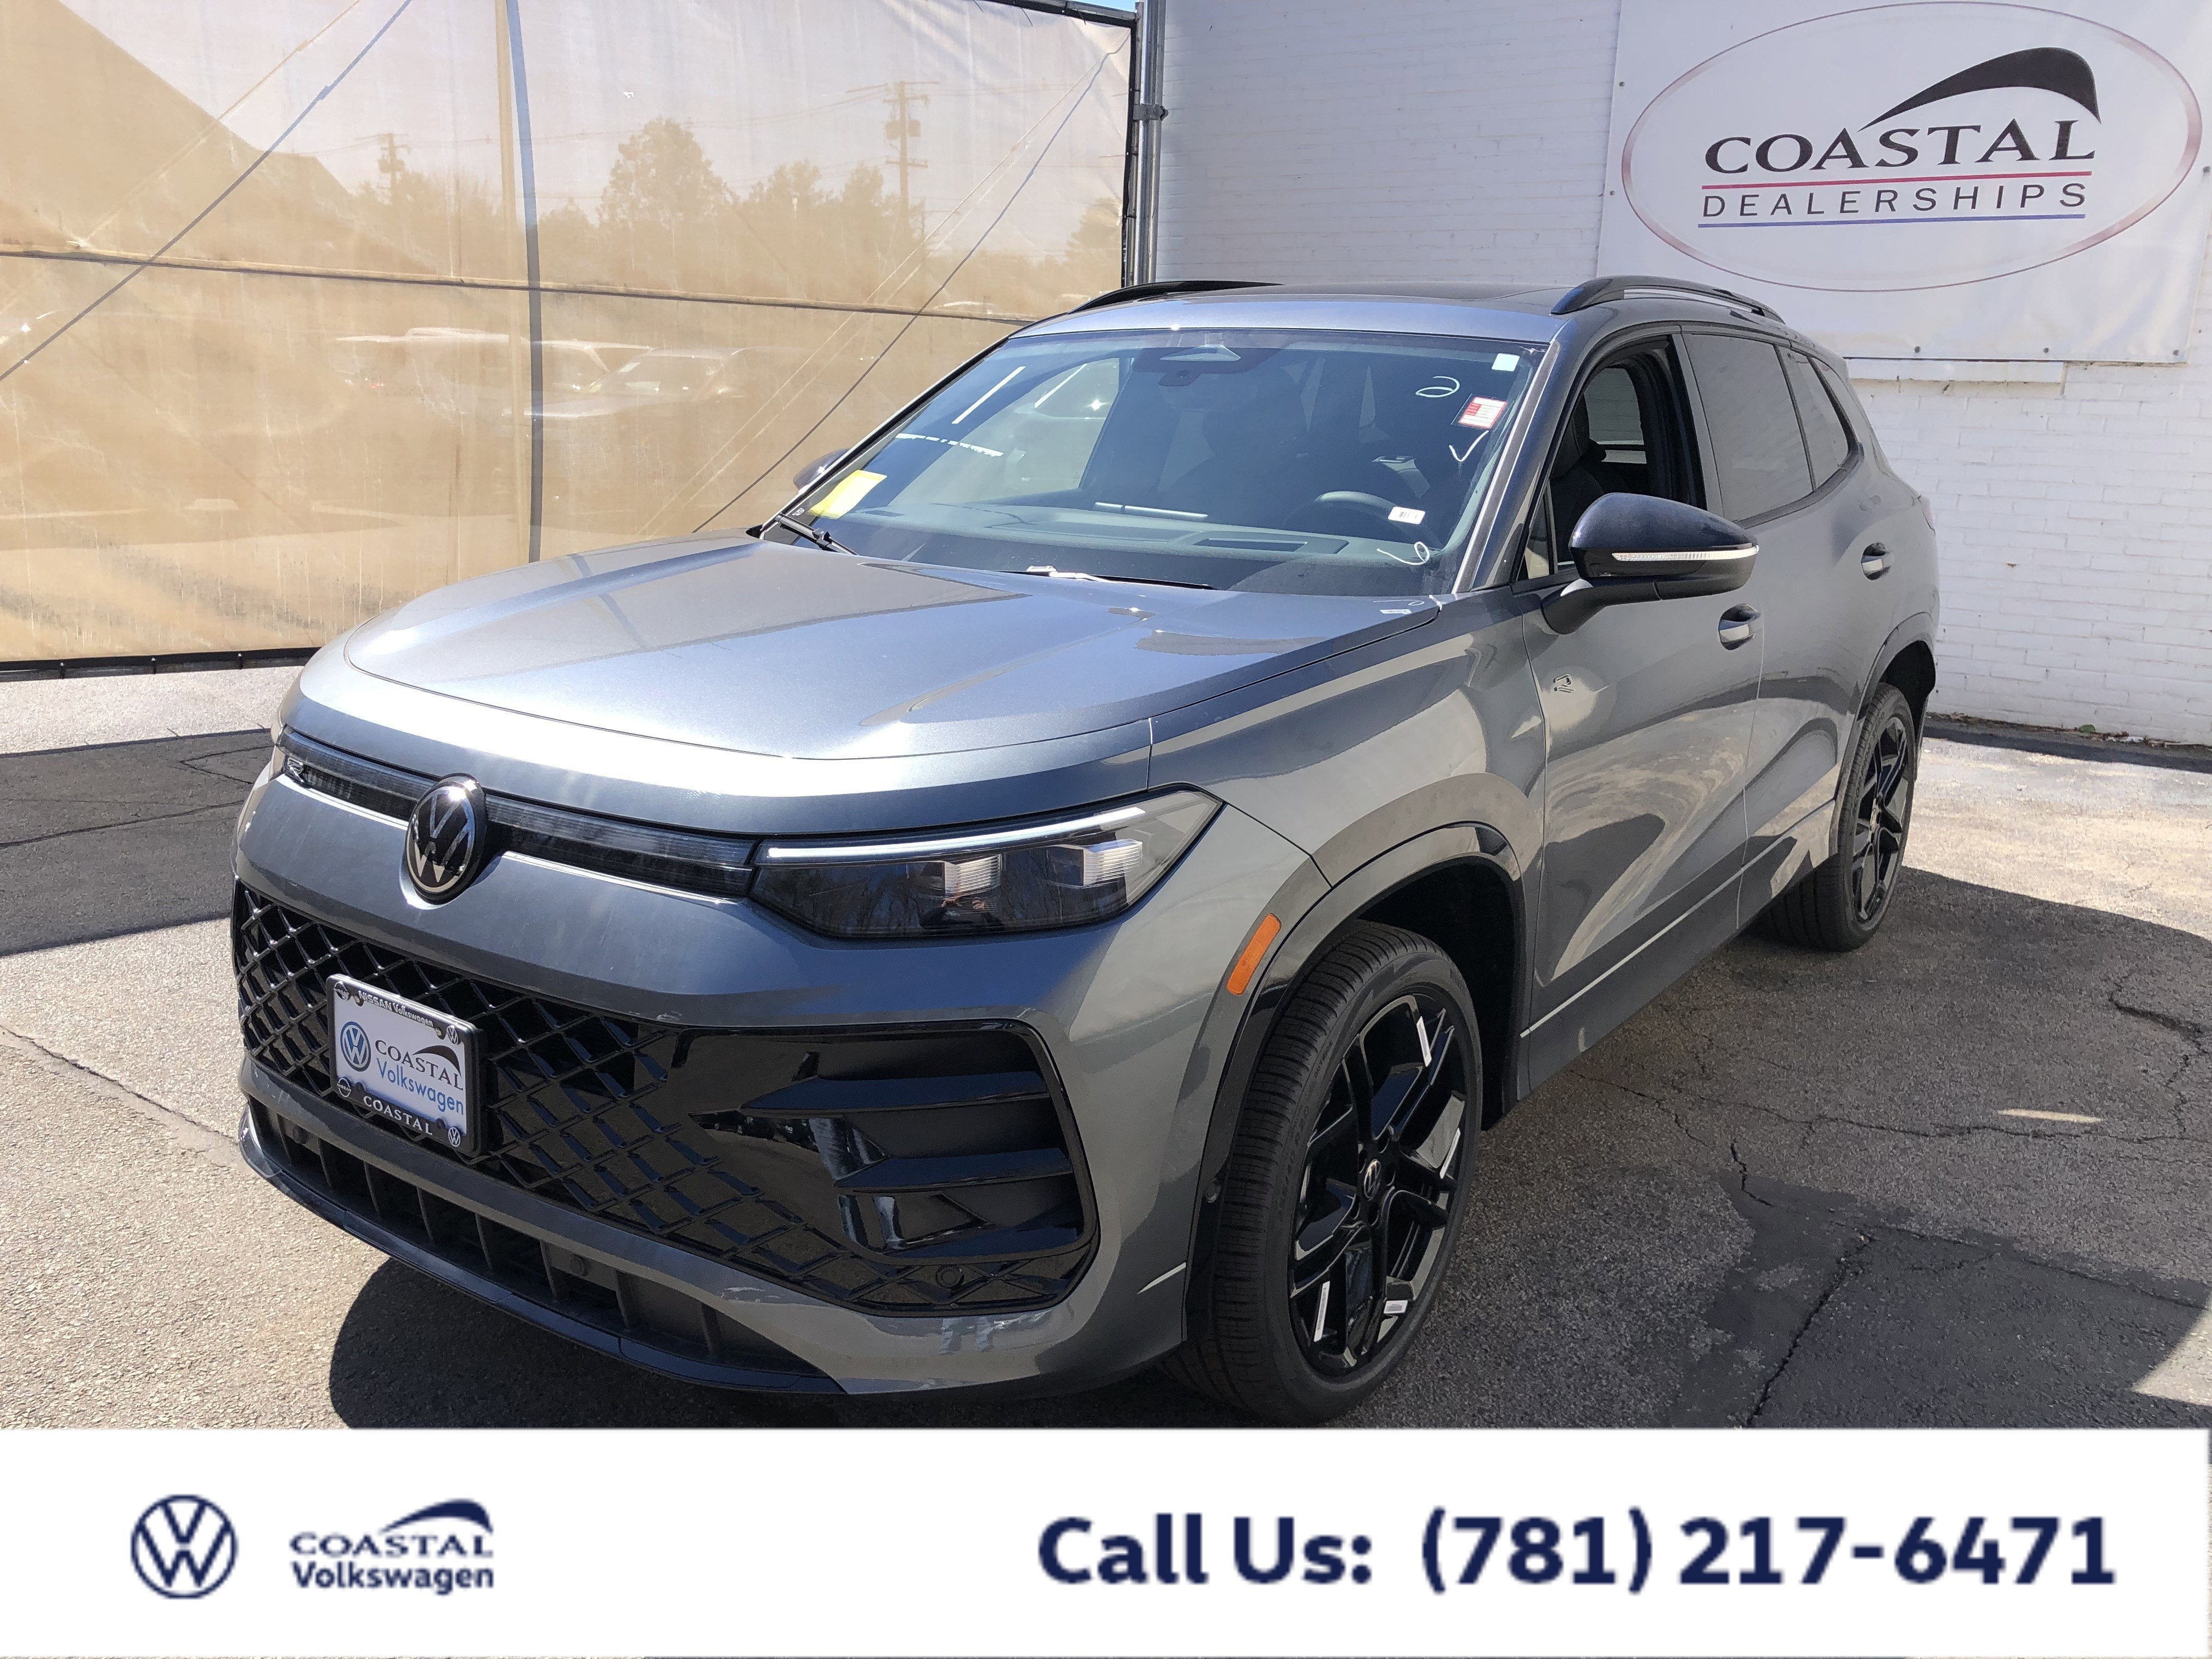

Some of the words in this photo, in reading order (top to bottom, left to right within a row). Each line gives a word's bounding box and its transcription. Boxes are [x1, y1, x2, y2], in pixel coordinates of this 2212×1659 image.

[1705, 119, 2095, 174] COASTAL
[1702, 183, 2086, 217] DEALERSHIPS
[358, 990, 392, 1011] NISSAN
[392, 1002, 433, 1027] Volkswagen
[375, 1039, 464, 1091] COASTAL
[376, 1057, 464, 1115] Volkswagen
[363, 1096, 433, 1136] COASTAL
